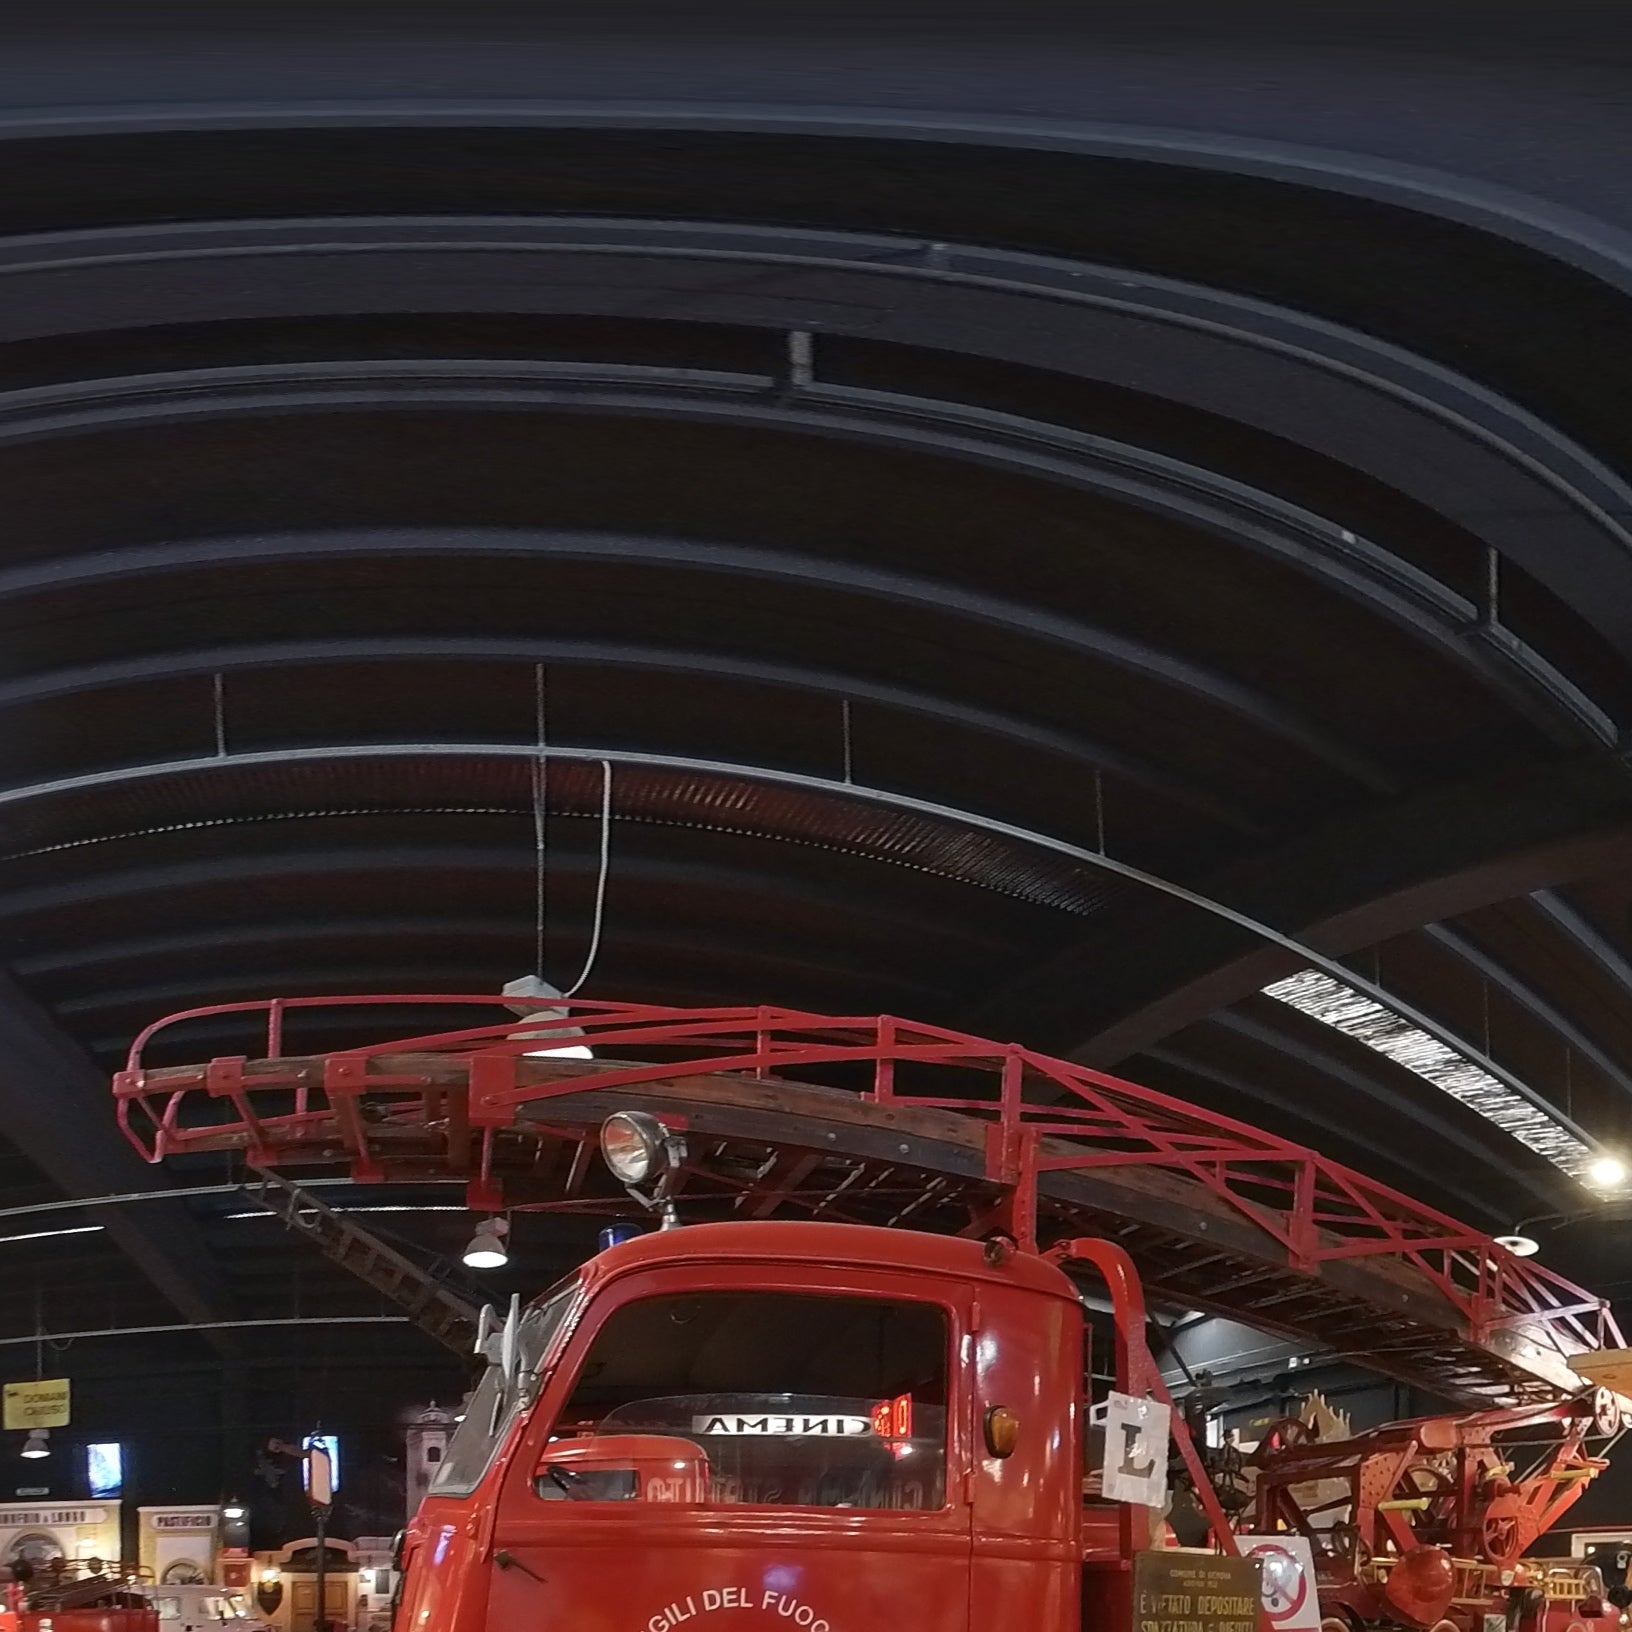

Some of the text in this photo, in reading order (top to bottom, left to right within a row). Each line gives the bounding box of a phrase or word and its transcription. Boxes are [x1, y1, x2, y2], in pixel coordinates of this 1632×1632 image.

[1116, 1424, 1156, 1478] L
[157, 1516, 211, 1527] PASTIFICIO
[702, 1587, 754, 1611] DEL
[1198, 1595, 1255, 1616] DEPOSITARE
